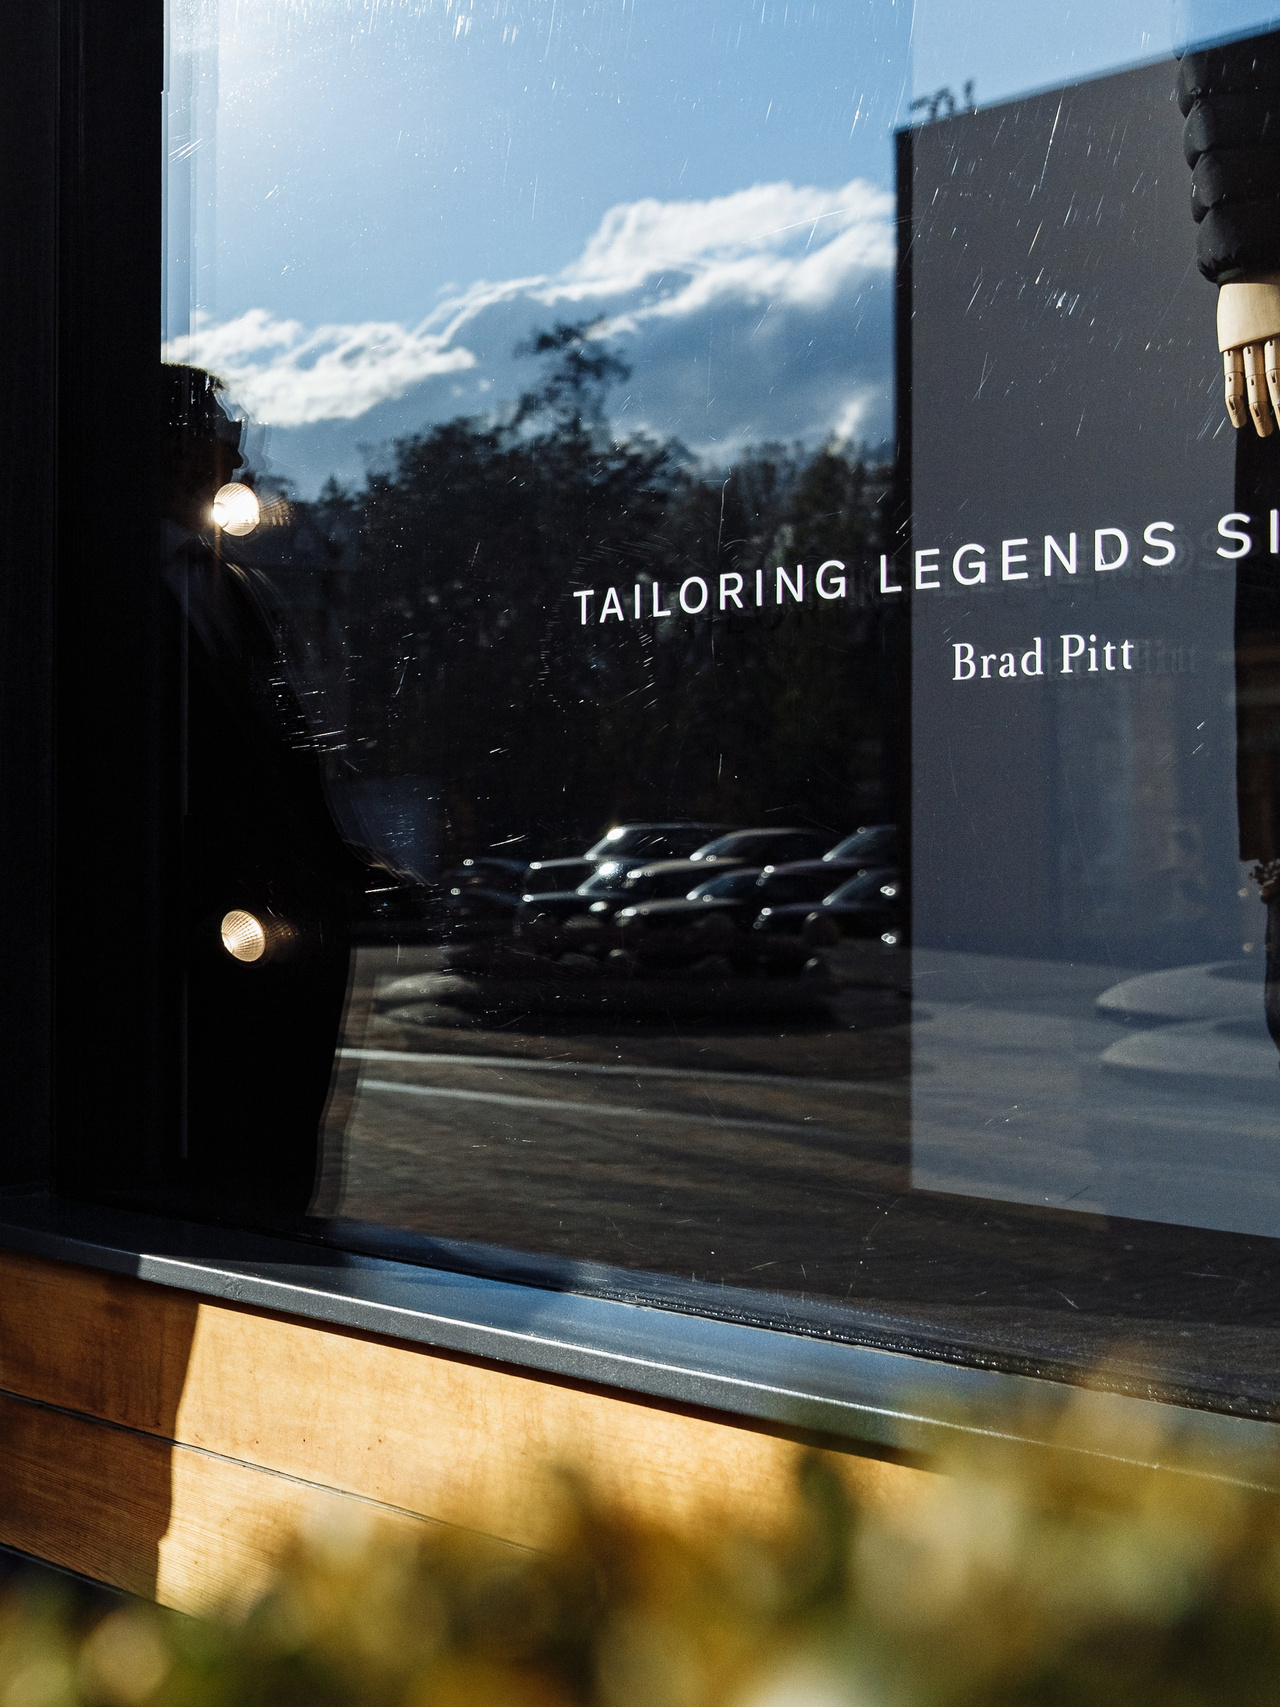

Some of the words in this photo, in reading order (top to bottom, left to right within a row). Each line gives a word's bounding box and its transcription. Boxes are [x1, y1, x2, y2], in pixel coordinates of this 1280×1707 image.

[572, 559, 846, 625] TAILORING
[880, 521, 1177, 594] LEGENDS
[951, 636, 1044, 681] Brad
[1059, 634, 1135, 674] Pitt
